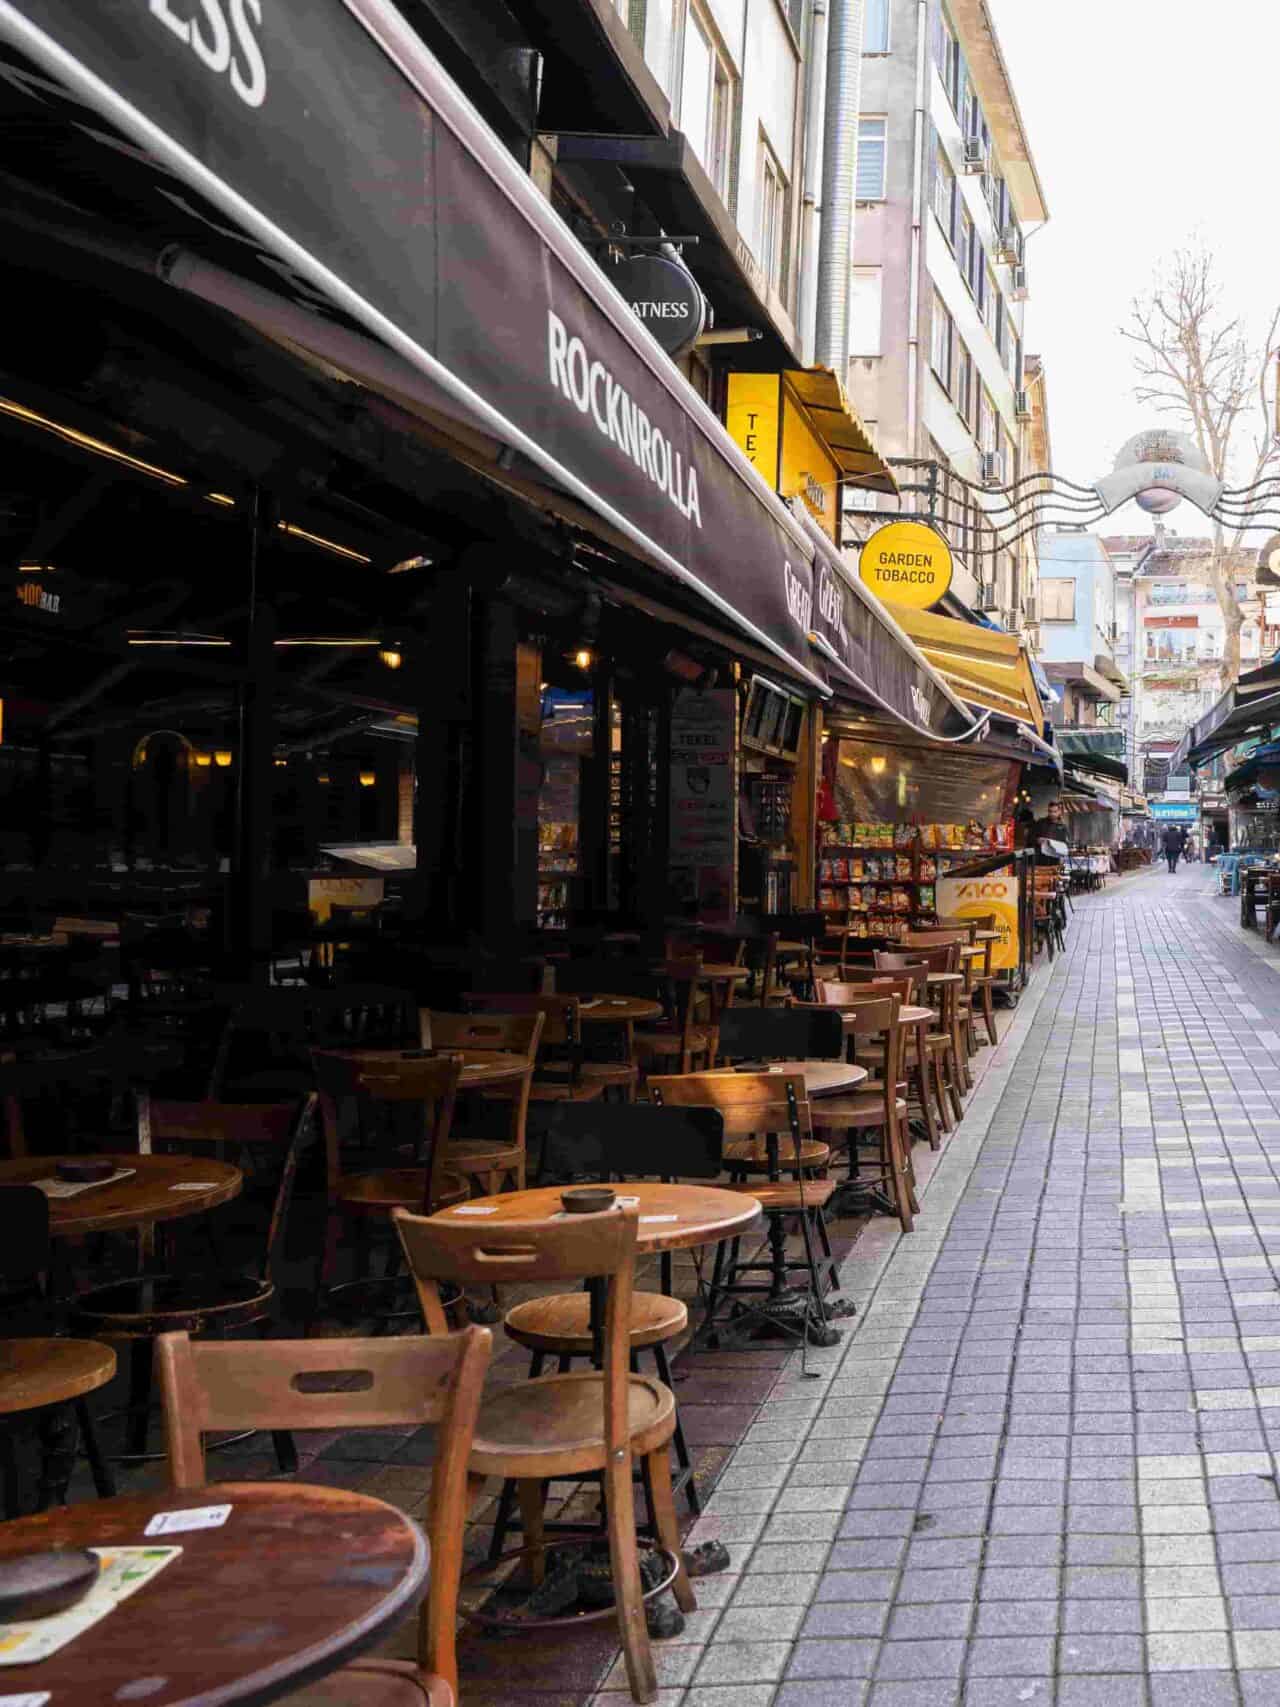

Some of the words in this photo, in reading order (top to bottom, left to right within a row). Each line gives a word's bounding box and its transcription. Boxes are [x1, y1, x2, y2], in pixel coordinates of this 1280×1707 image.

[630, 302, 689, 318] ATNESS
[547, 310, 702, 528] ROCKNROLLA
[879, 552, 933, 568] GARDEN
[874, 568, 935, 584] TOBACCO
